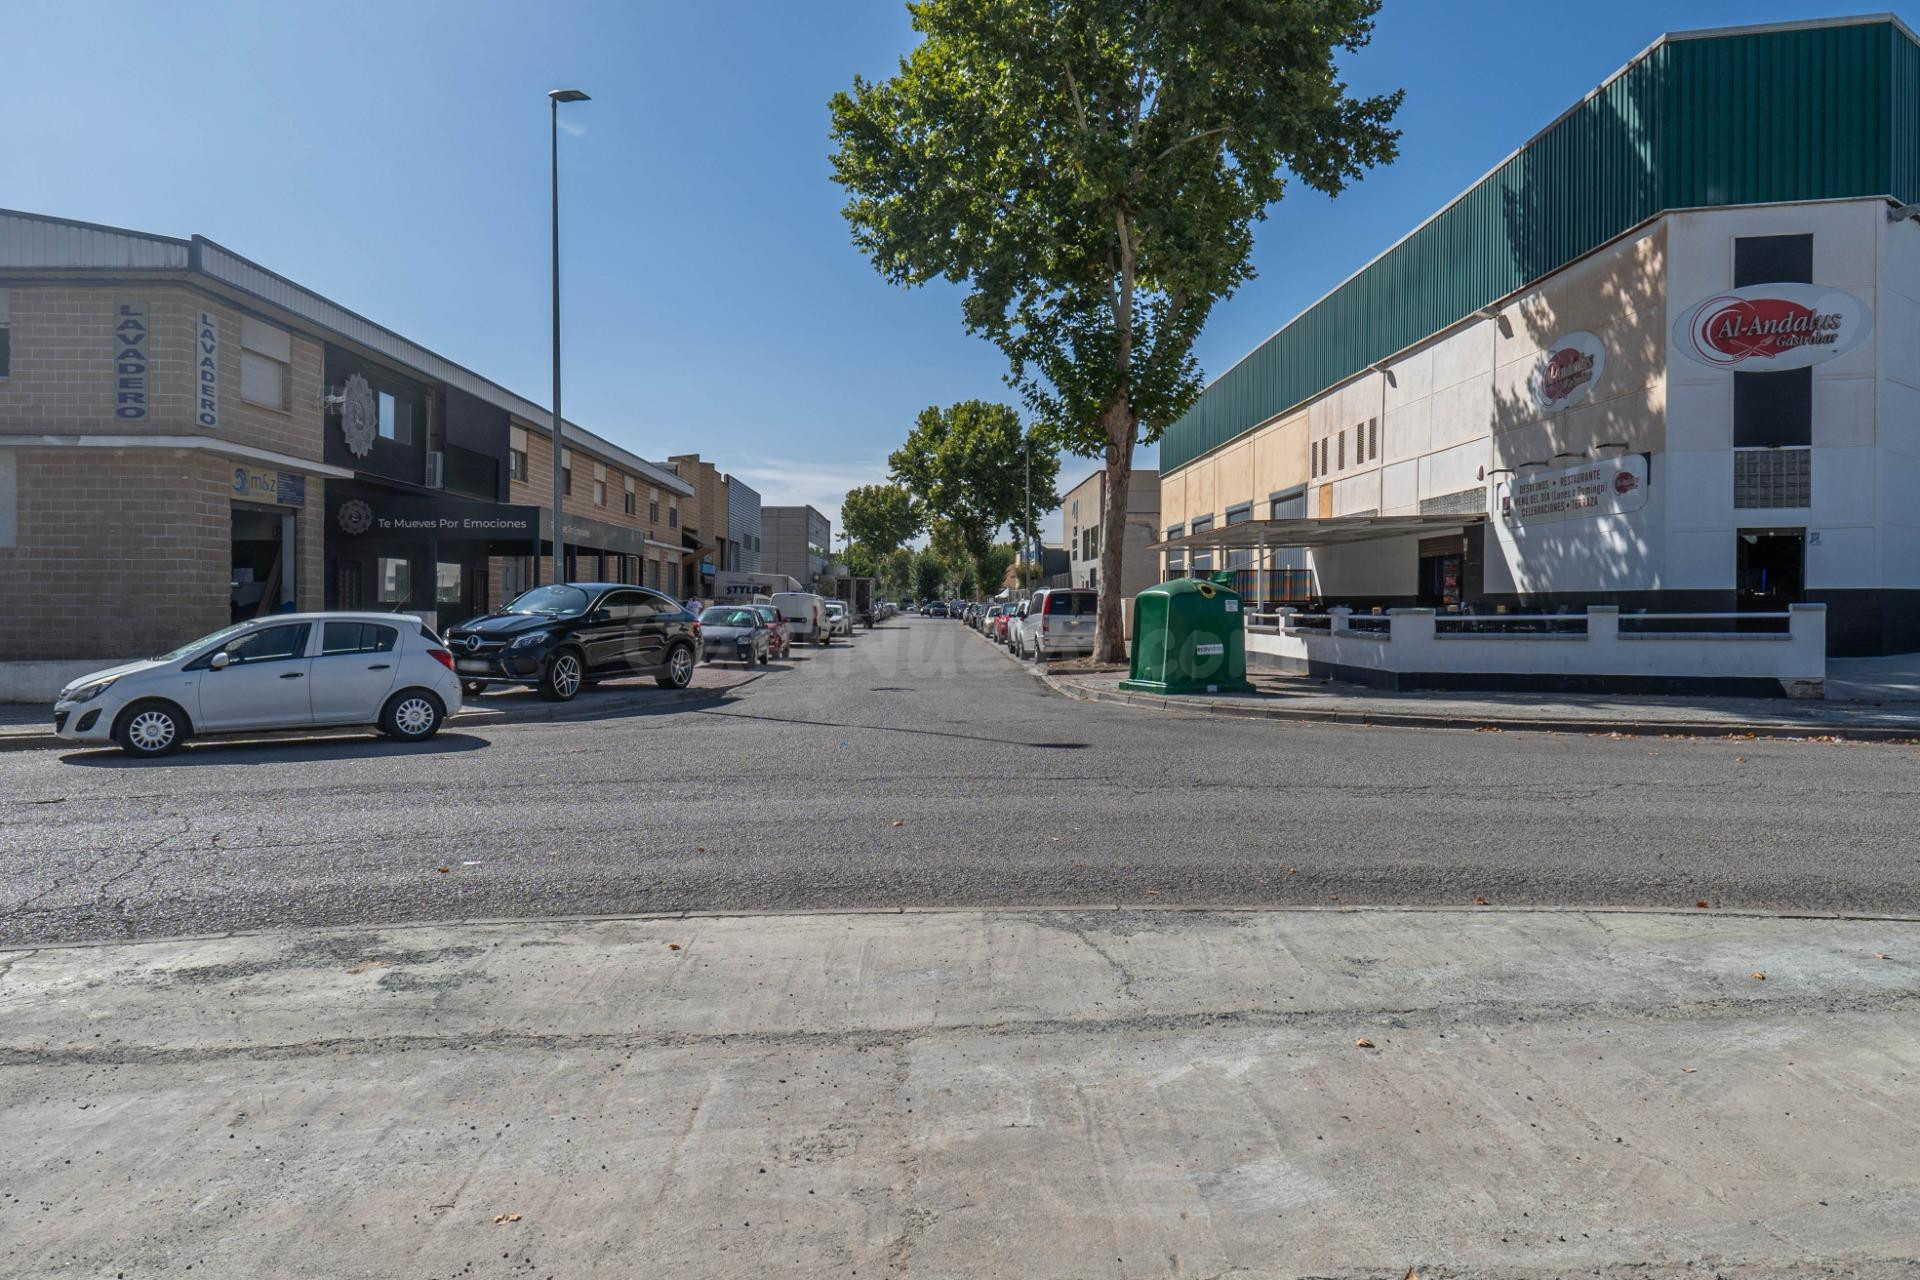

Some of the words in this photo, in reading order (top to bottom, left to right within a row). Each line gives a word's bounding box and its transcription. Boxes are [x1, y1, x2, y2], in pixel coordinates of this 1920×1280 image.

[1717, 308, 1843, 341] Al-Andalus
[115, 304, 146, 418] LAVADERO
[199, 313, 217, 426] LAVADERO
[1560, 469, 1601, 487] RESTAURANTE
[1521, 501, 1565, 517] CELEBRACIONES
[377, 518, 391, 528] Te
[394, 518, 437, 528] Mueves
[439, 518, 460, 528] Por
[463, 518, 528, 528] Emociones
